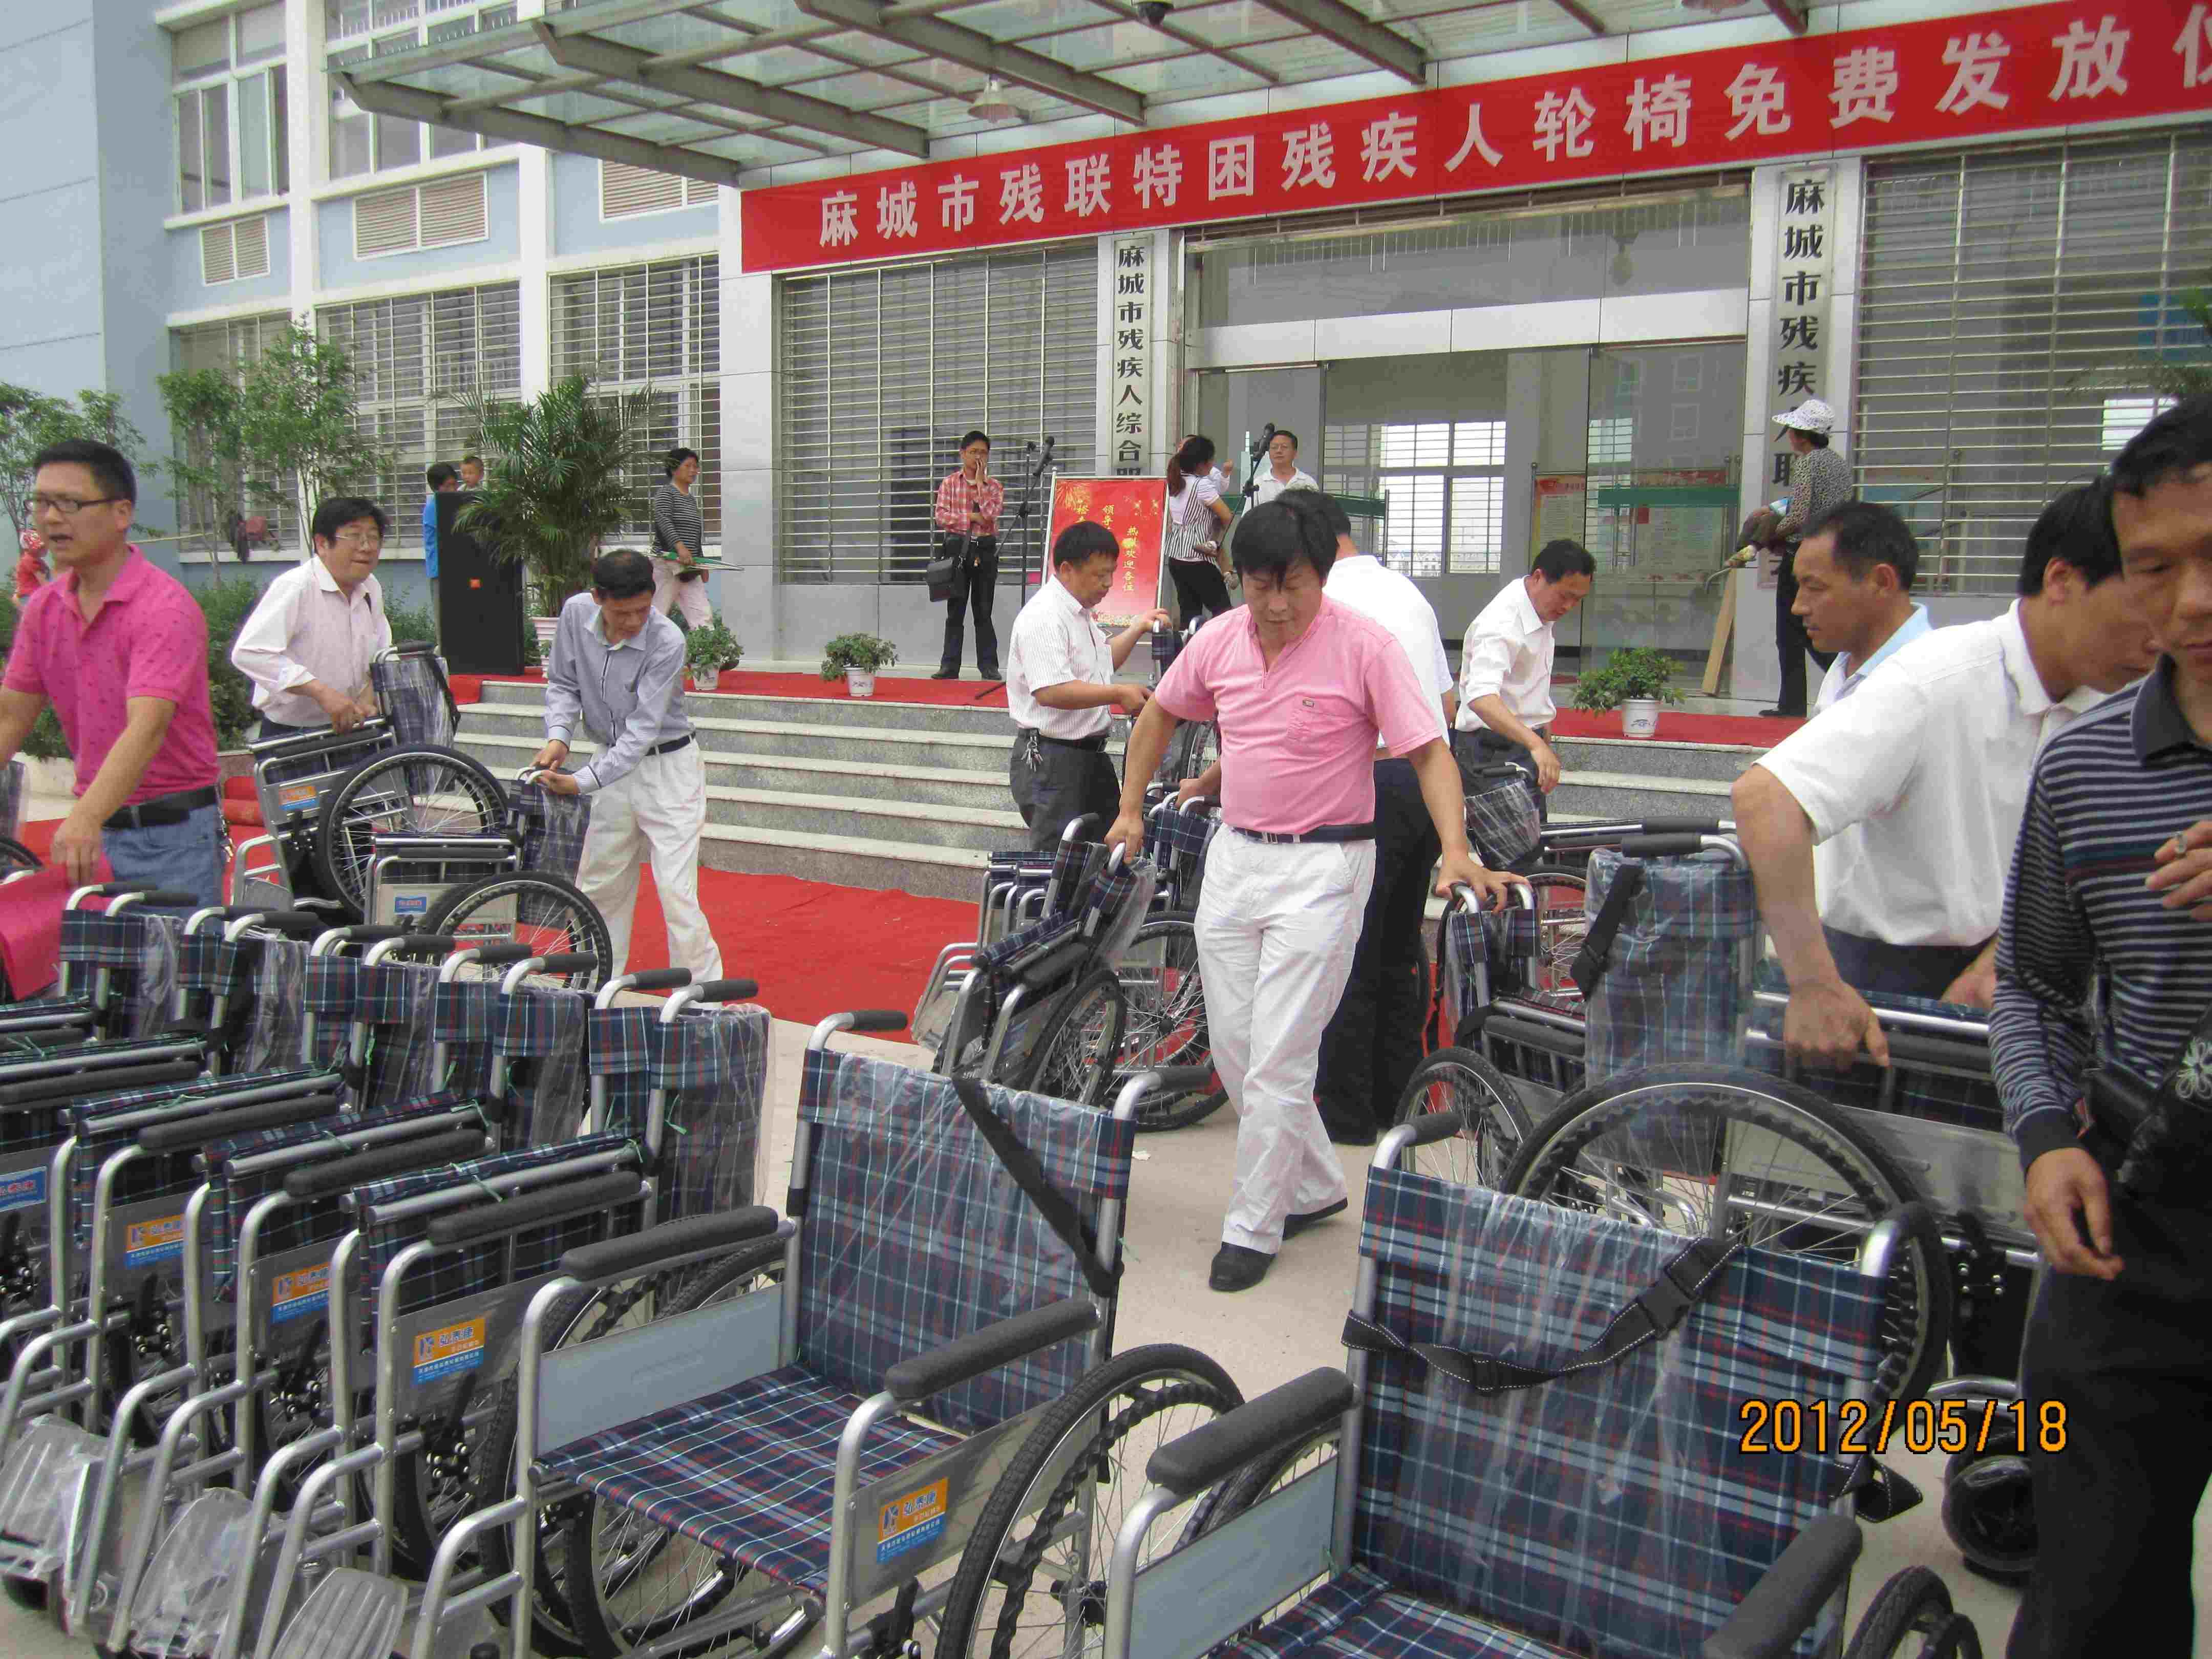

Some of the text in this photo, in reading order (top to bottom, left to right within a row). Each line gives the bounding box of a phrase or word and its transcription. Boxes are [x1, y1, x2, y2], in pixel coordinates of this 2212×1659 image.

[1774, 179, 1826, 486] 麻城市残疾
